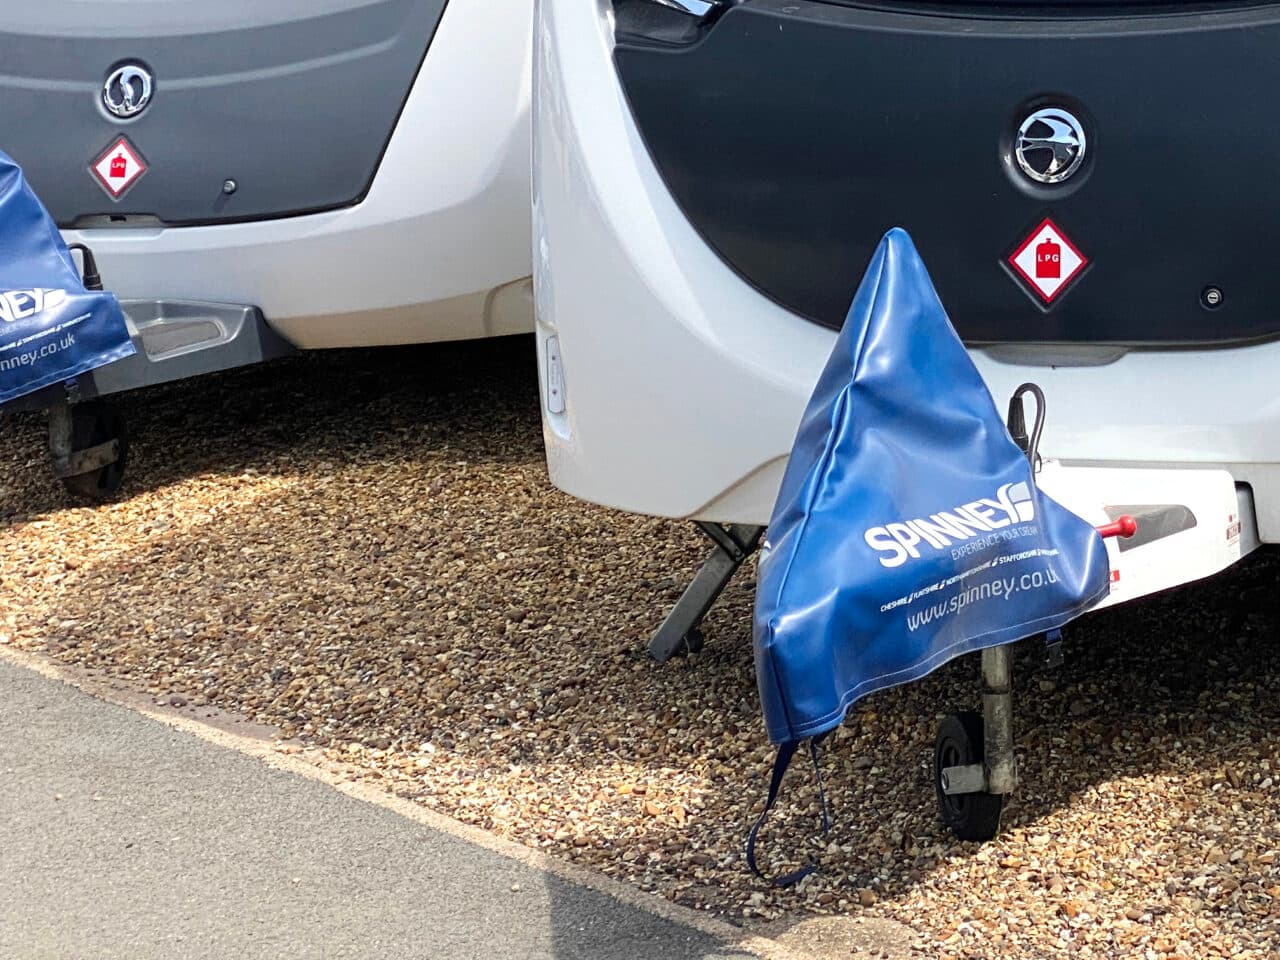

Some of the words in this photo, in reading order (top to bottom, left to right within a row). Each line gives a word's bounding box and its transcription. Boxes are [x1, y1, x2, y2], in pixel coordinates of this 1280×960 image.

[1037, 253, 1060, 263] LPG
[864, 482, 1021, 568] SPINNEY
[951, 533, 1001, 561] EXPERIENCE
[1001, 527, 1020, 542] YOUR
[880, 596, 908, 613] CHESHIRE
